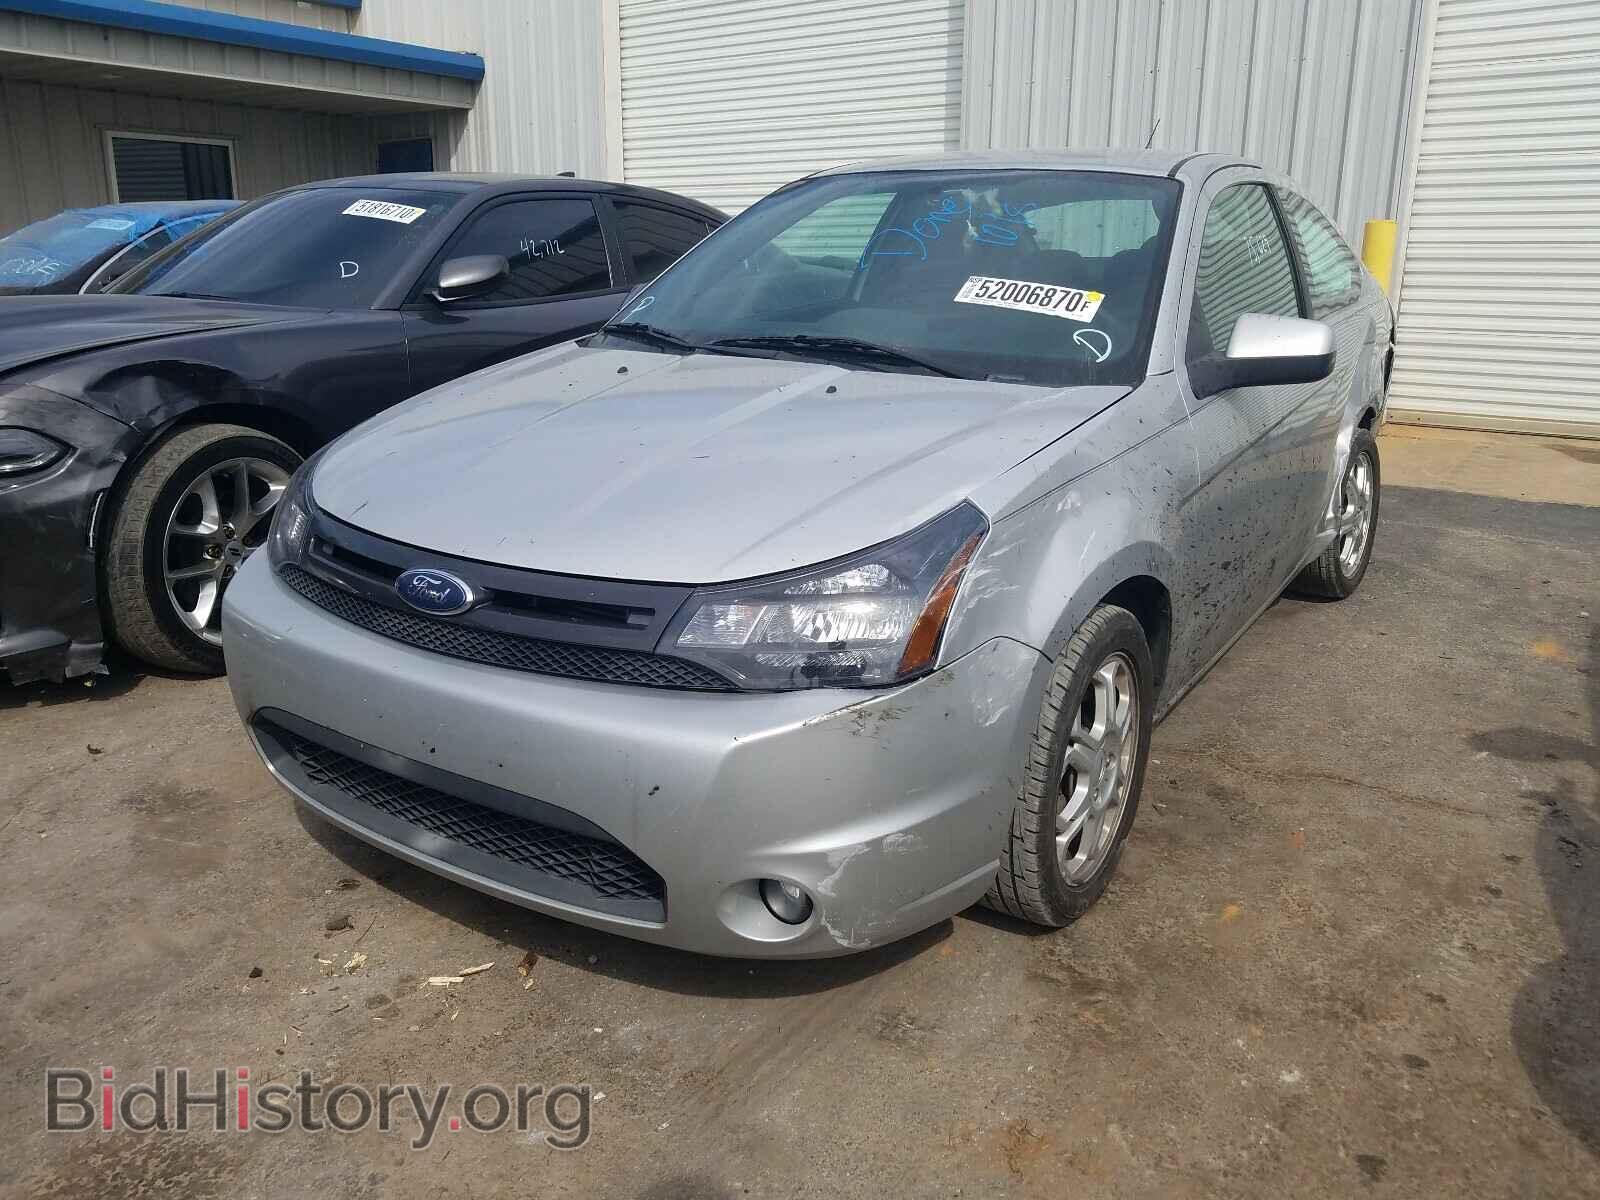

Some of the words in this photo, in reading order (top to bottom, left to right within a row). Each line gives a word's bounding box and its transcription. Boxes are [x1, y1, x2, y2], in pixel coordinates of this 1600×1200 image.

[355, 201, 415, 219] 51816710
[340, 261, 359, 278] D
[975, 279, 1084, 313] 52006870
[1073, 328, 1112, 363] D
